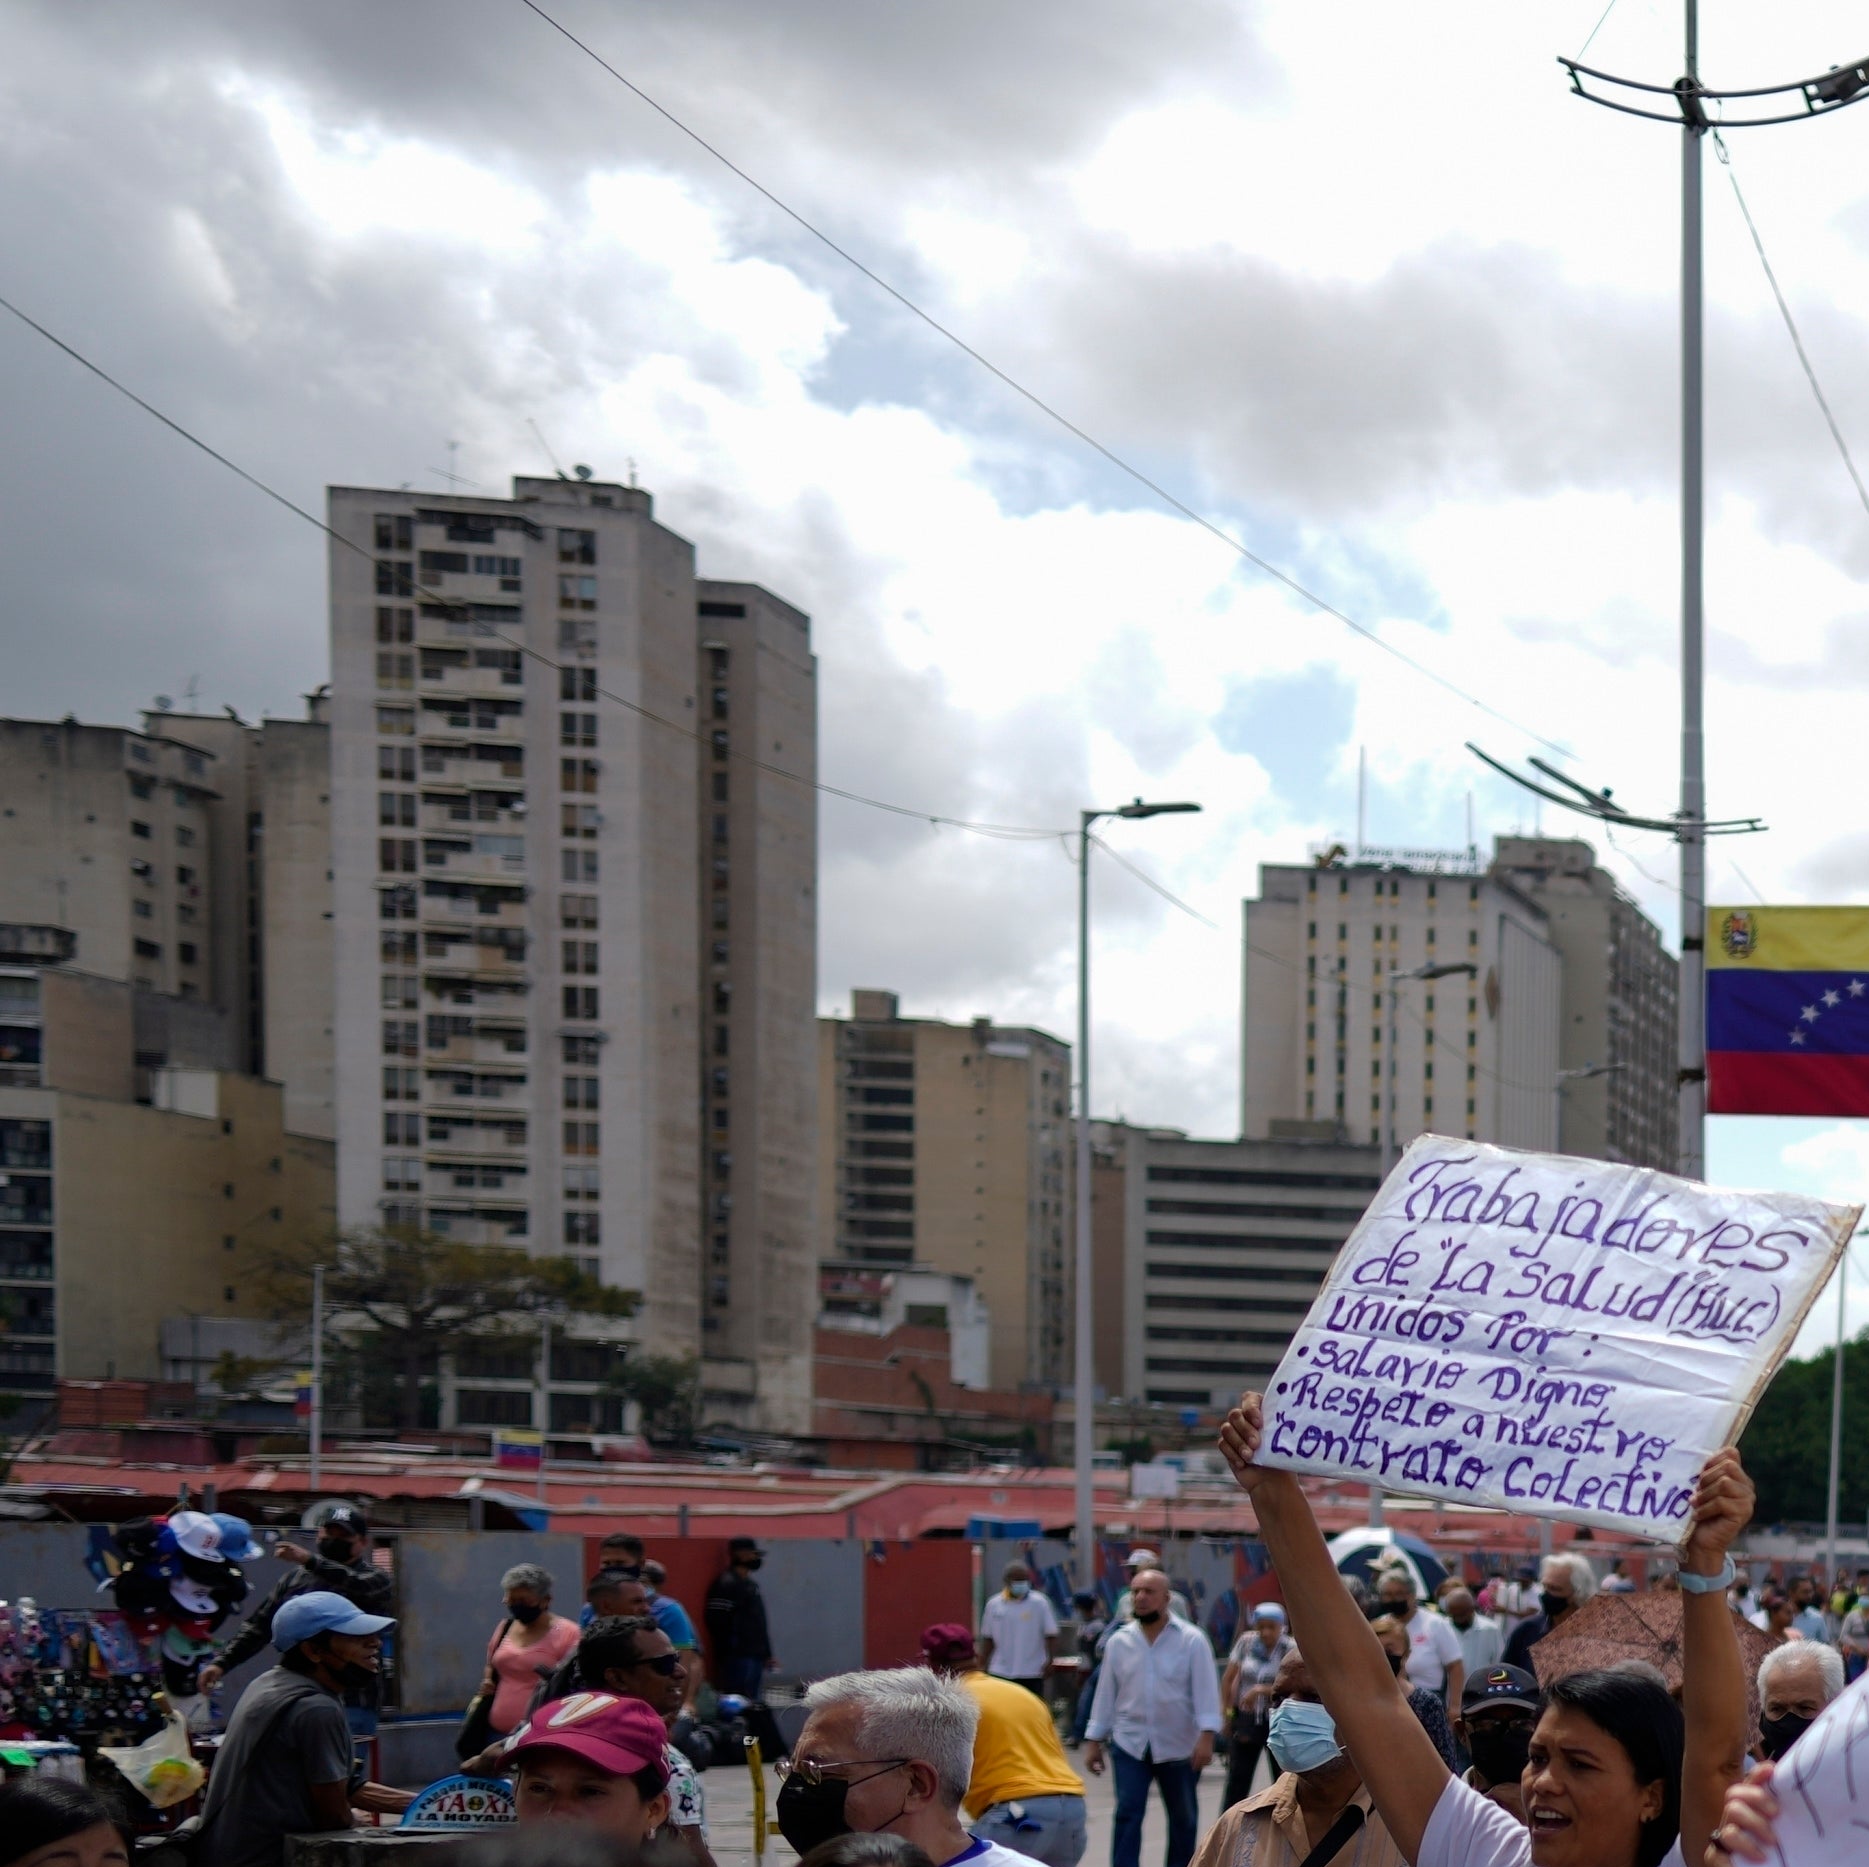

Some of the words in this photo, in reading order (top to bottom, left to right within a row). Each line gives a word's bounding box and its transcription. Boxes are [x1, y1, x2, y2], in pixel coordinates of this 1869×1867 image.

[1404, 1154, 1809, 1273] Trabajadores
[1353, 1230, 1420, 1287] de
[1462, 1414, 1484, 1438] a
[1495, 1407, 1675, 1463] nuestro
